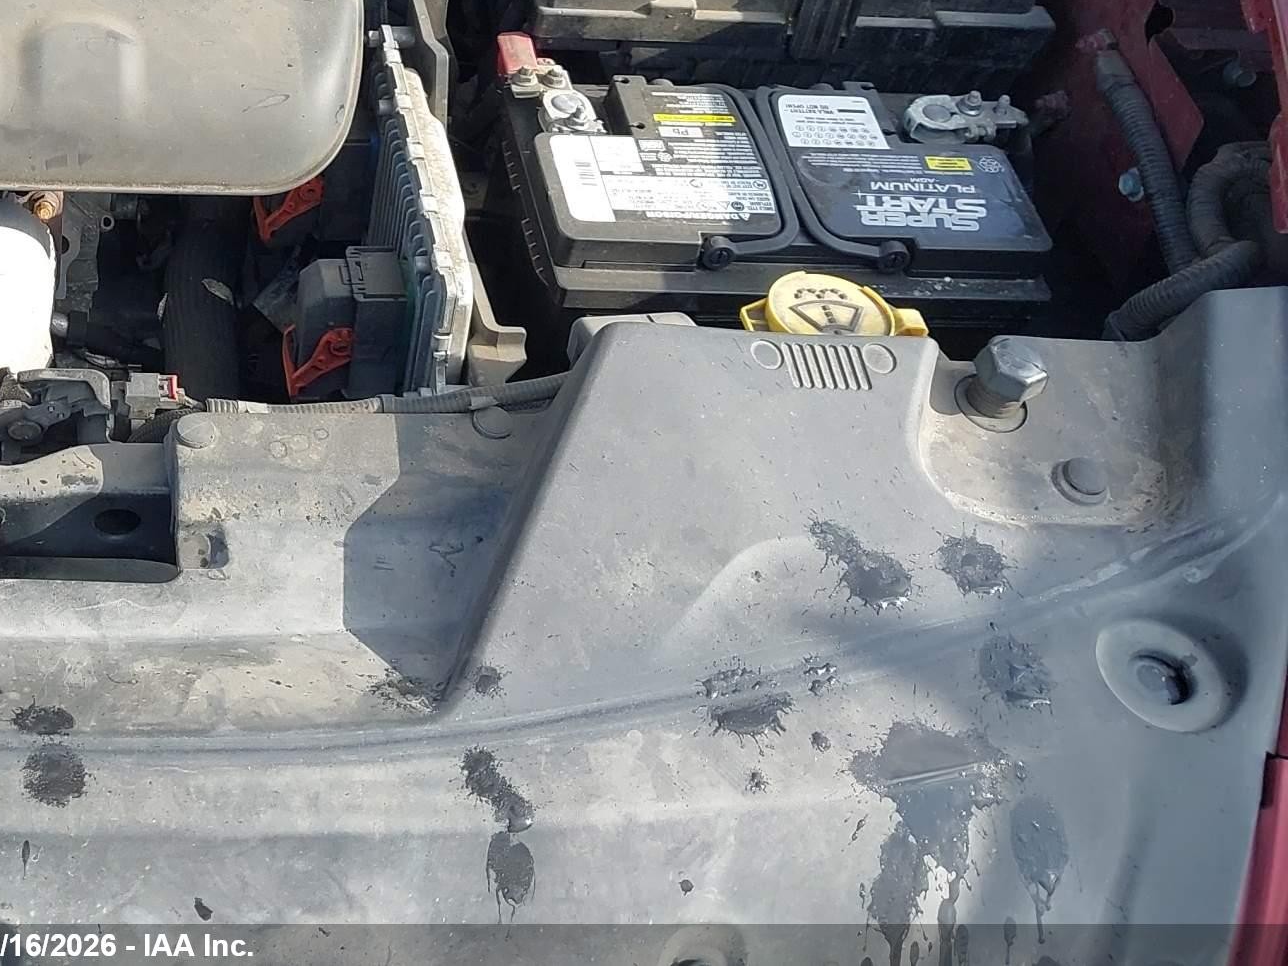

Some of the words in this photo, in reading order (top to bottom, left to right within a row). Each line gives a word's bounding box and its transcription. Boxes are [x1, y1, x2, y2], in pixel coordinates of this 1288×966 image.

[672, 128, 689, 136] Pb
[870, 181, 976, 194] PLATINUM
[855, 195, 987, 218] START
[861, 211, 980, 231] SUPER
